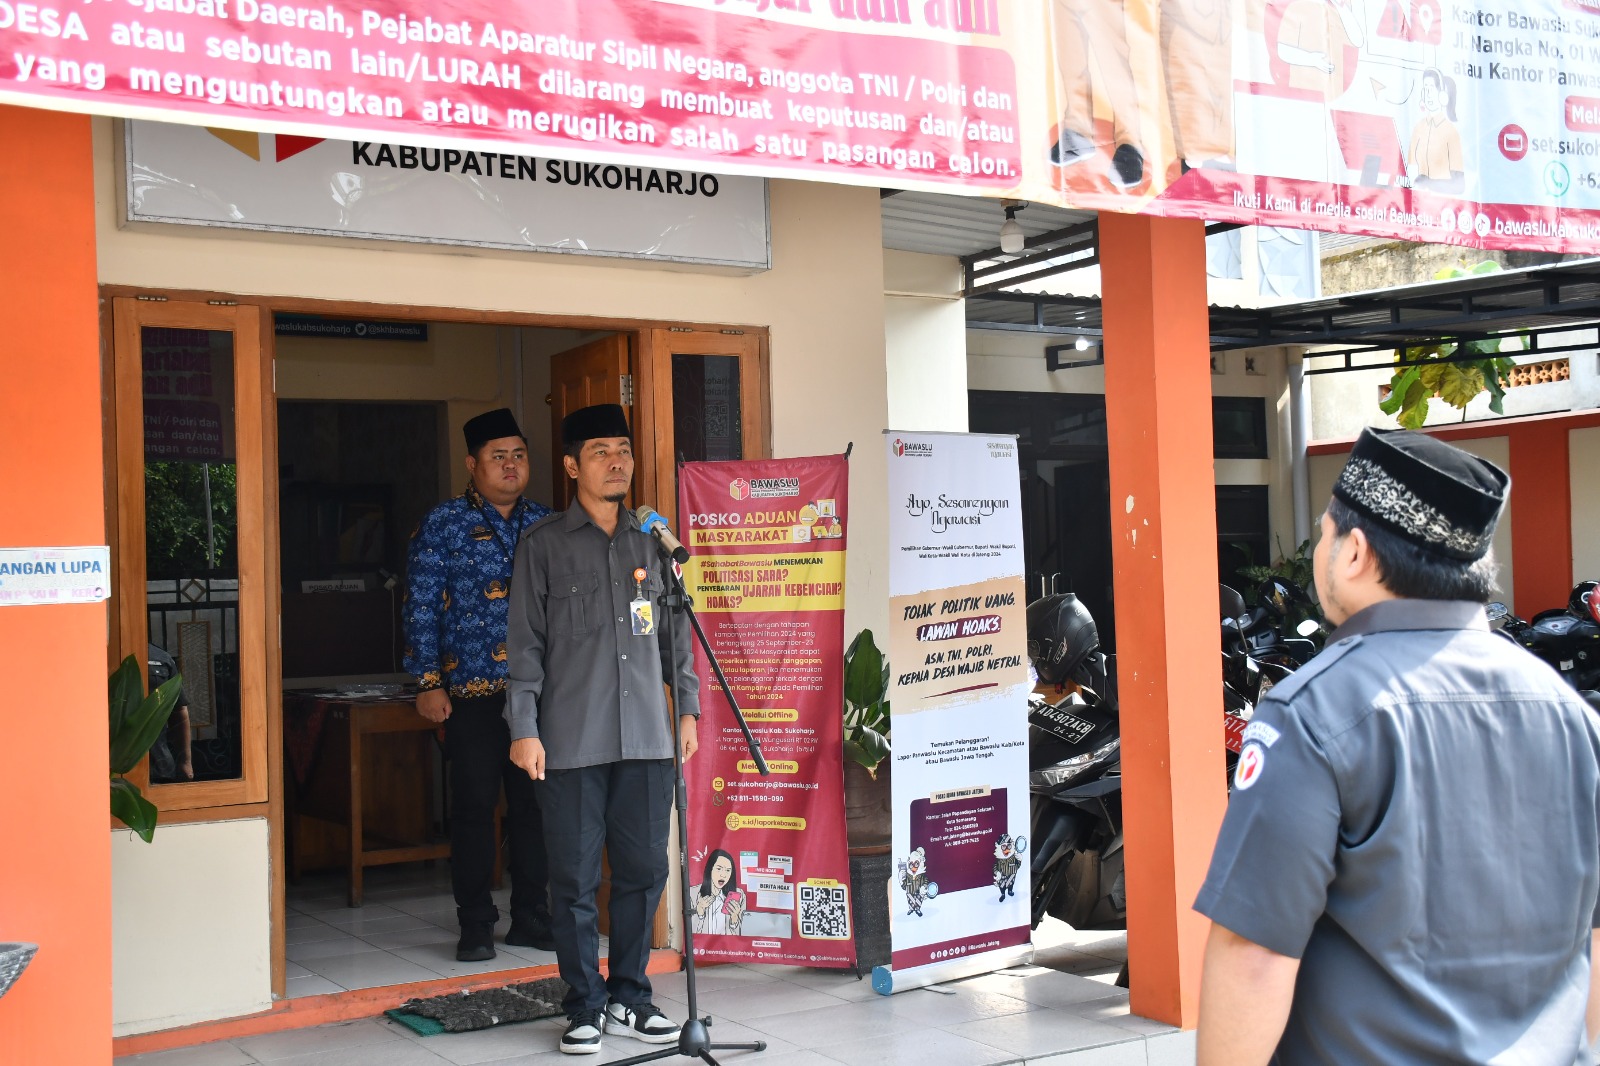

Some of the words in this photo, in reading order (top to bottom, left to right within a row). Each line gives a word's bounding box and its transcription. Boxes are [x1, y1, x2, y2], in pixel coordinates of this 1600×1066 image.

[1452, 5, 1502, 27] Kantor
[1507, 11, 1570, 33] Bawaslu
[1575, 19, 1600, 39] Suk
[237, 0, 353, 39] Daerah,
[361, 11, 473, 46] Pejabat
[480, 29, 595, 60] Aparatur
[602, 41, 656, 71] Sipil
[664, 47, 754, 88] Negara,
[760, 67, 854, 95] anggota
[859, 73, 898, 98] TNI
[921, 79, 967, 107] Polri
[973, 85, 1012, 111] dan
[1471, 35, 1533, 57] Nangka
[1538, 40, 1564, 59] No.
[1454, 61, 1482, 80] atau
[1489, 63, 1543, 83] Kantor
[111, 21, 185, 52] atau
[206, 35, 331, 71] sebutan
[351, 48, 521, 90] lain/LURAH
[539, 69, 645, 108] dilarang
[660, 88, 773, 120] membuat
[788, 98, 906, 133] keputusan
[919, 112, 1014, 144] dan/atau
[15, 54, 106, 90] yang
[130, 66, 403, 118] menguntungkan
[421, 99, 489, 126] atau
[507, 108, 655, 144] merugikan
[671, 124, 739, 153] salah
[755, 133, 807, 157] satu
[822, 142, 935, 170] pasangan
[949, 151, 1016, 177] calon.
[352, 141, 537, 181] KABUPATEN
[545, 160, 720, 198] SUKOHARJO
[1233, 190, 1261, 210] Ikuti
[1265, 193, 1296, 213] Kami
[1300, 197, 1311, 215] di
[1315, 200, 1351, 219] media
[1355, 203, 1386, 223] sosial
[1389, 207, 1433, 228] Bawaslu
[904, 443, 932, 451] BAWASLU
[751, 479, 798, 488] BAWASLU
[690, 513, 740, 526] POSKO
[744, 511, 796, 525] ADUAN
[697, 530, 788, 543] MASYARAKAT
[62, 561, 102, 573] LUPA
[774, 558, 823, 566] MENEMUKAN
[703, 571, 754, 583] POLITISASI
[757, 569, 789, 582] SARA?
[743, 584, 781, 597] UJARAN
[785, 582, 842, 596] KEBENCIAN?
[706, 596, 742, 608] HOAKS?
[903, 602, 936, 621] TOLAK
[940, 596, 982, 615] POLITIK
[920, 622, 958, 641] LAWAN
[898, 669, 930, 686] KEPALA
[932, 664, 955, 680] DESA
[957, 660, 985, 676] WAJIB
